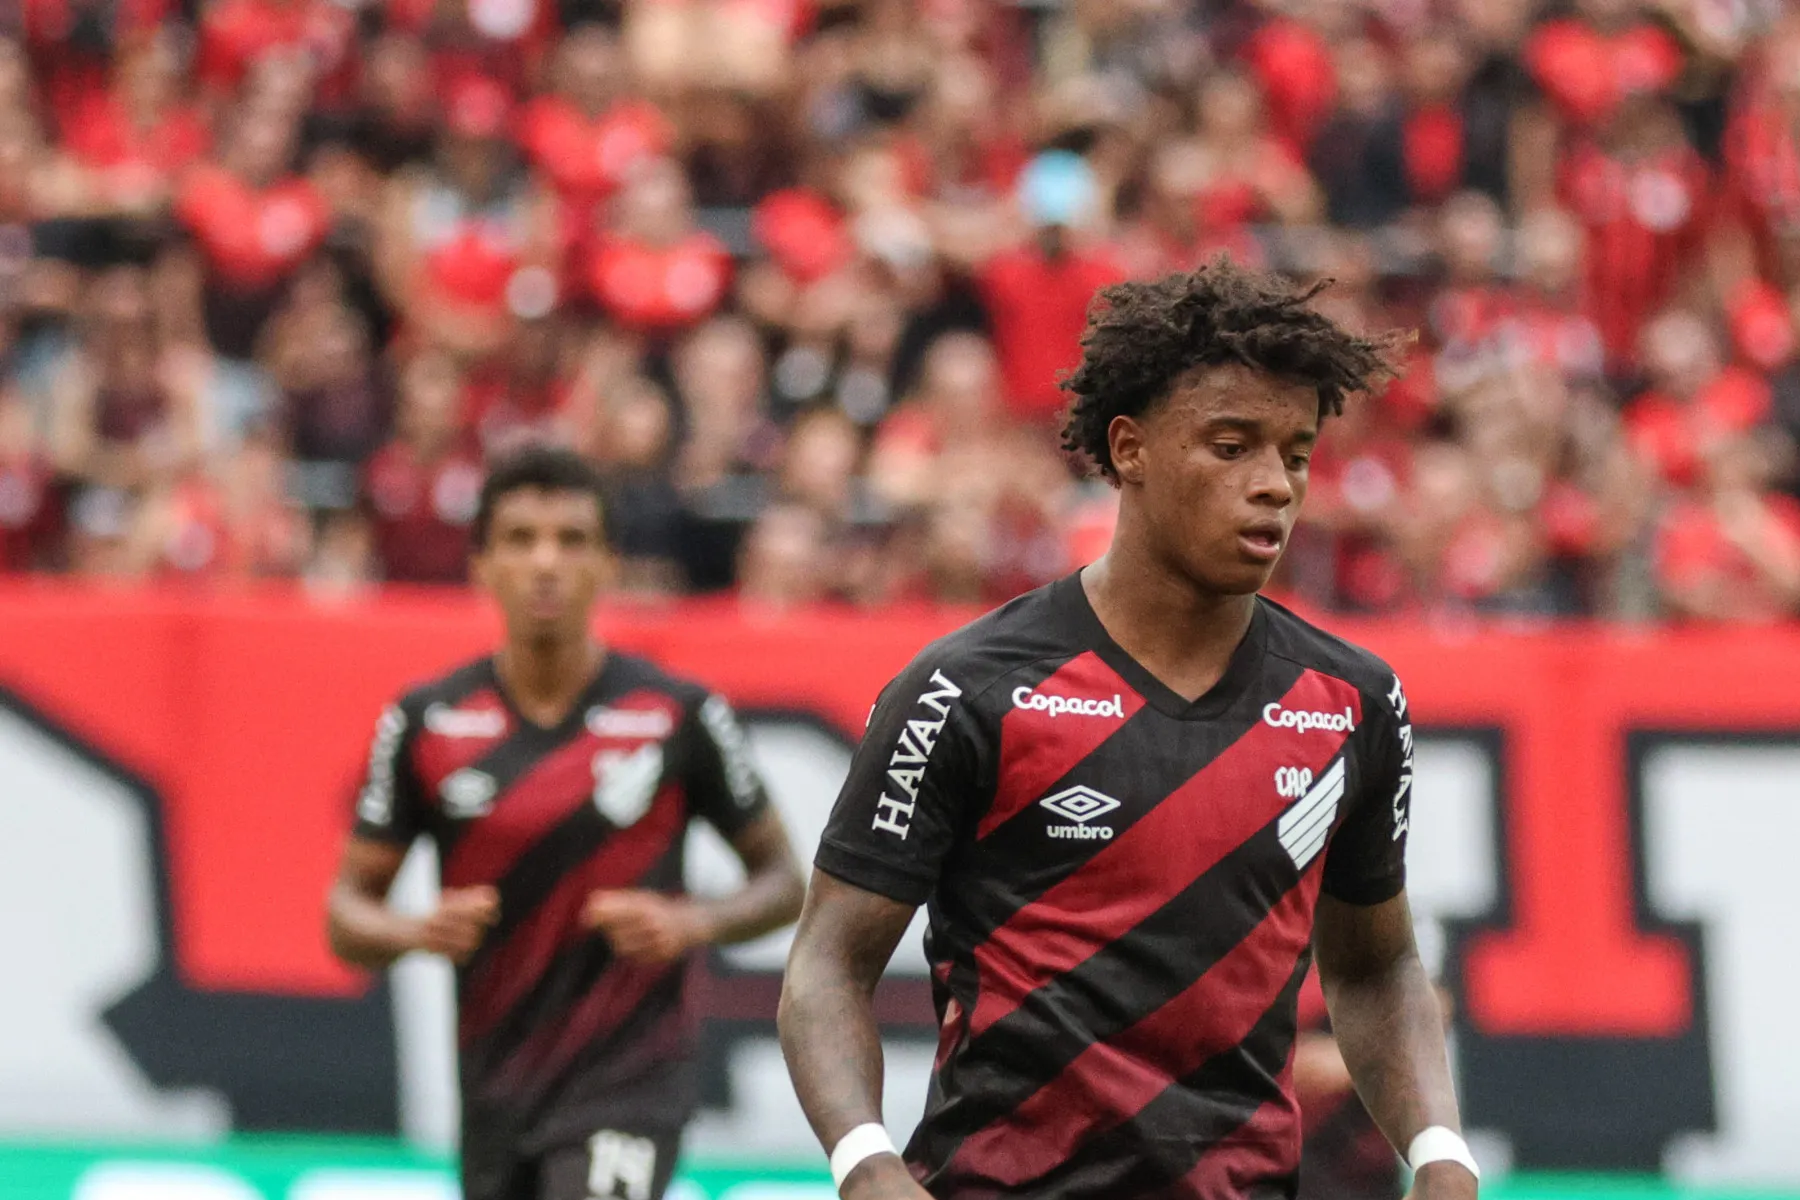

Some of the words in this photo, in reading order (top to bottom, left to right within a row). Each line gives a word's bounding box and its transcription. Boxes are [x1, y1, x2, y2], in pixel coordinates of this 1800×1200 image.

[1011, 685, 1124, 718] Copacol
[1263, 702, 1355, 733] Copacol
[872, 668, 962, 841] HAVAN
[1047, 823, 1113, 840] umbro
